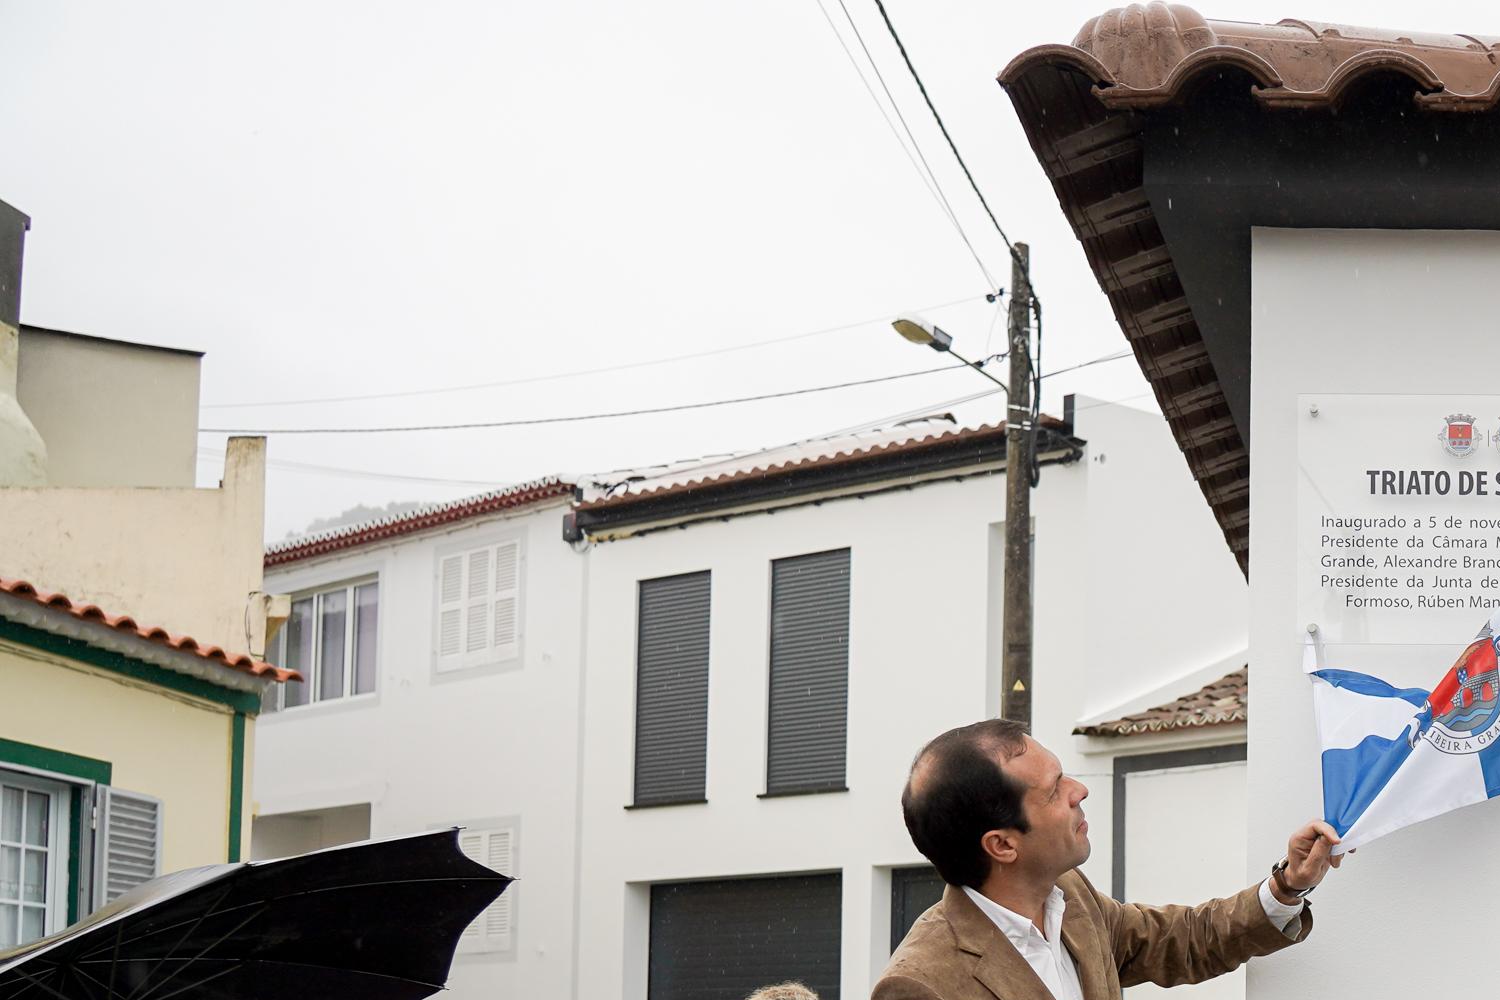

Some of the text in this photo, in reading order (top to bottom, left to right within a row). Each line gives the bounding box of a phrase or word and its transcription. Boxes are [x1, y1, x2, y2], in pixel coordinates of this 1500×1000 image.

[1366, 470, 1451, 496] TRIATO
[1458, 471, 1488, 496] DE
[1321, 515, 1407, 532] Inaugurado
[1413, 518, 1421, 529] a
[1428, 516, 1437, 529] 5
[1444, 515, 1463, 529] de
[1321, 534, 1399, 548] Presidente
[1406, 535, 1424, 548] da
[1432, 536, 1488, 549] Câmara
[1320, 554, 1378, 569] Grande,
[1383, 555, 1458, 569] Alexandre
[1321, 575, 1398, 588] Presidente
[1406, 575, 1424, 588] da
[1432, 576, 1472, 589] Junta
[1480, 576, 1499, 589] de
[1346, 594, 1413, 609] Formoso,
[1418, 595, 1464, 609] Rúben
[1429, 730, 1472, 751] IBEIRA
